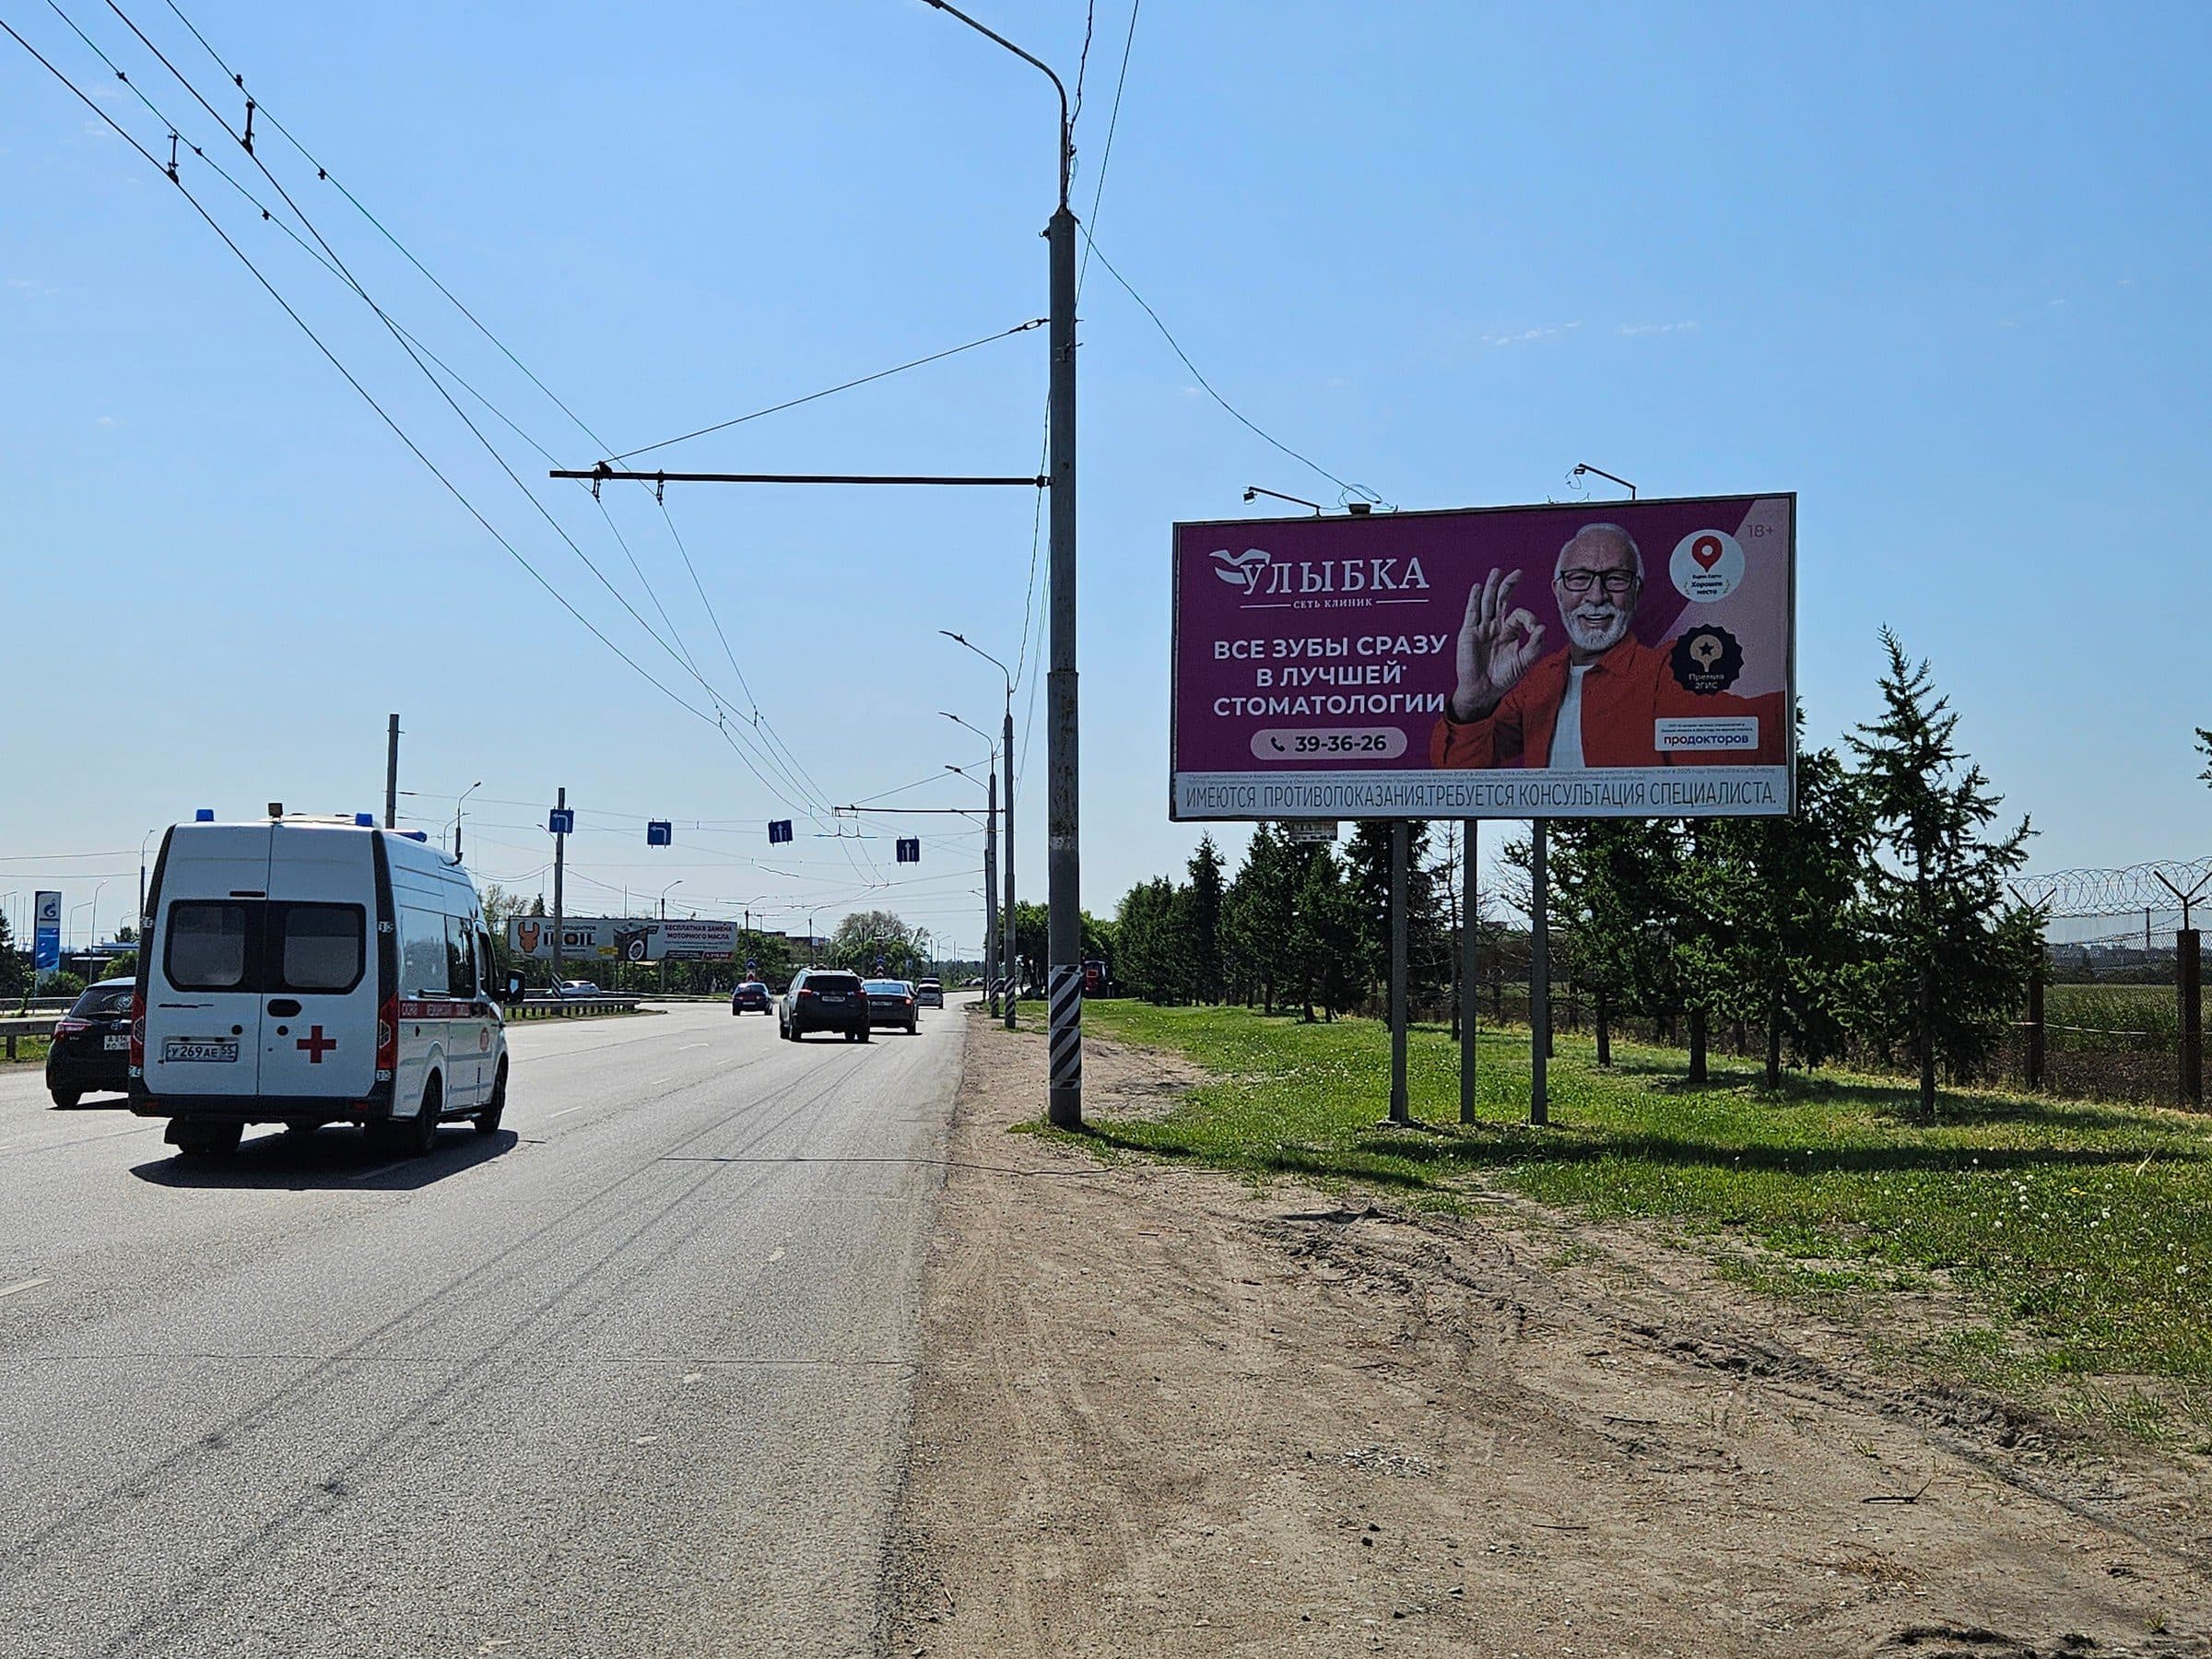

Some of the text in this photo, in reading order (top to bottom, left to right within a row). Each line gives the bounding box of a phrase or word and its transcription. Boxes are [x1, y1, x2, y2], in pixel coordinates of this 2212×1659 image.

[1747, 524, 1774, 538] 18+
[1240, 557, 1430, 595] УЛЫБКА
[1293, 598, 1372, 609] СЕТЬ КЛИНИК
[1214, 634, 1448, 660] ВСЕ ЗУБЫ СРАЗУ
[1256, 668, 1273, 687] В
[1688, 673, 1724, 682] Премия
[1213, 693, 1445, 717] СТОМАТОЛОГИИ
[1294, 735, 1387, 752] 39-36-26
[1665, 735, 1749, 747] продокторов
[1186, 786, 1255, 808] ИМЕЮТСЯ
[1519, 782, 1645, 808] КОНСУЛЬТАЦИЯ
[1650, 782, 1777, 807] СПЕЦИАЛИСТА.
